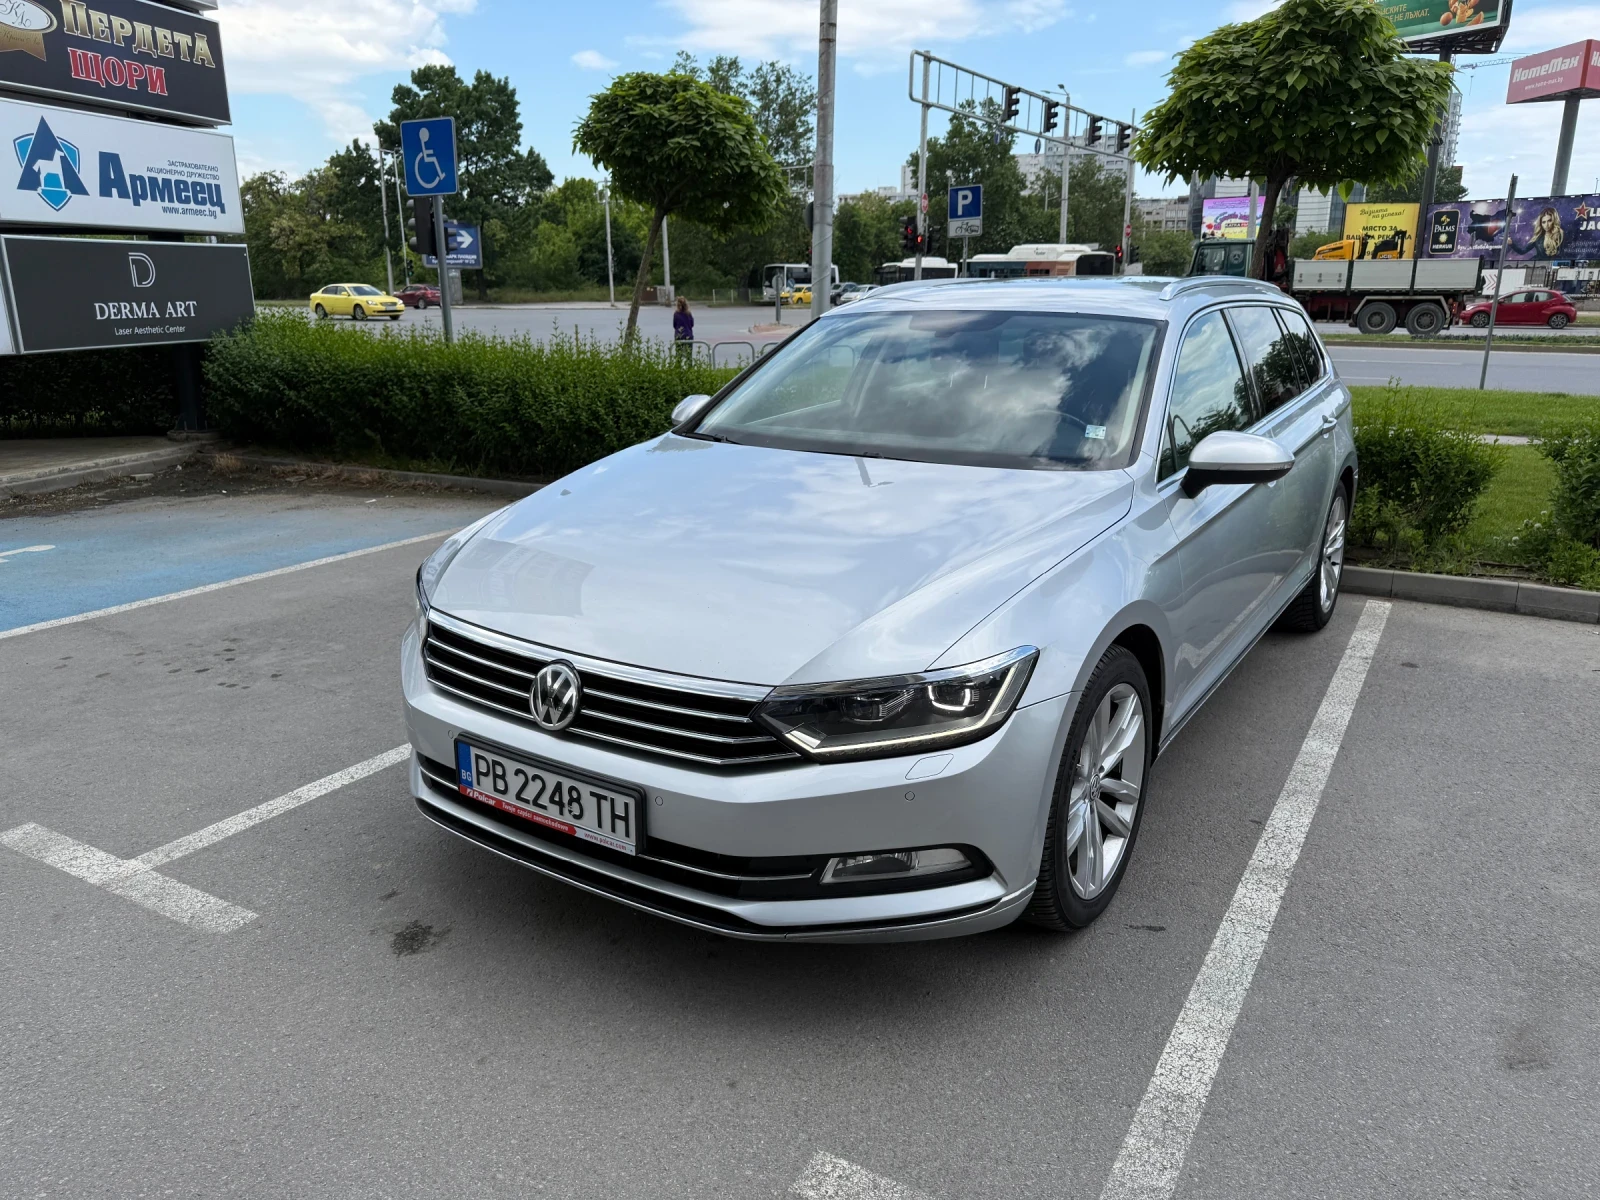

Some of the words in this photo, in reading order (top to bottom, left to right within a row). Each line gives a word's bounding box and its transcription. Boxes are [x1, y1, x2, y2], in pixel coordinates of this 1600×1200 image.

[60, 0, 216, 68] ПЕРДЕТА
[68, 47, 168, 96] ЩОРИ
[1512, 56, 1580, 83] HomeMax
[98, 151, 226, 214] Армеец
[146, 166, 186, 177] АКЦИОНЕРНО
[186, 170, 220, 181] ДРУЖЕСТВО
[161, 206, 217, 219] www.armeec.bg
[957, 190, 973, 216] P
[1434, 224, 1456, 233] PALMS
[94, 302, 160, 320] DERMA
[166, 301, 197, 317] ART
[115, 327, 132, 335] Laser
[134, 325, 164, 334] Aesthetic
[165, 325, 186, 333] Center
[461, 769, 472, 782] BG
[473, 791, 496, 806] Polcar
[475, 753, 509, 796] PB
[514, 768, 584, 820] 2248
[590, 791, 630, 838] TH
